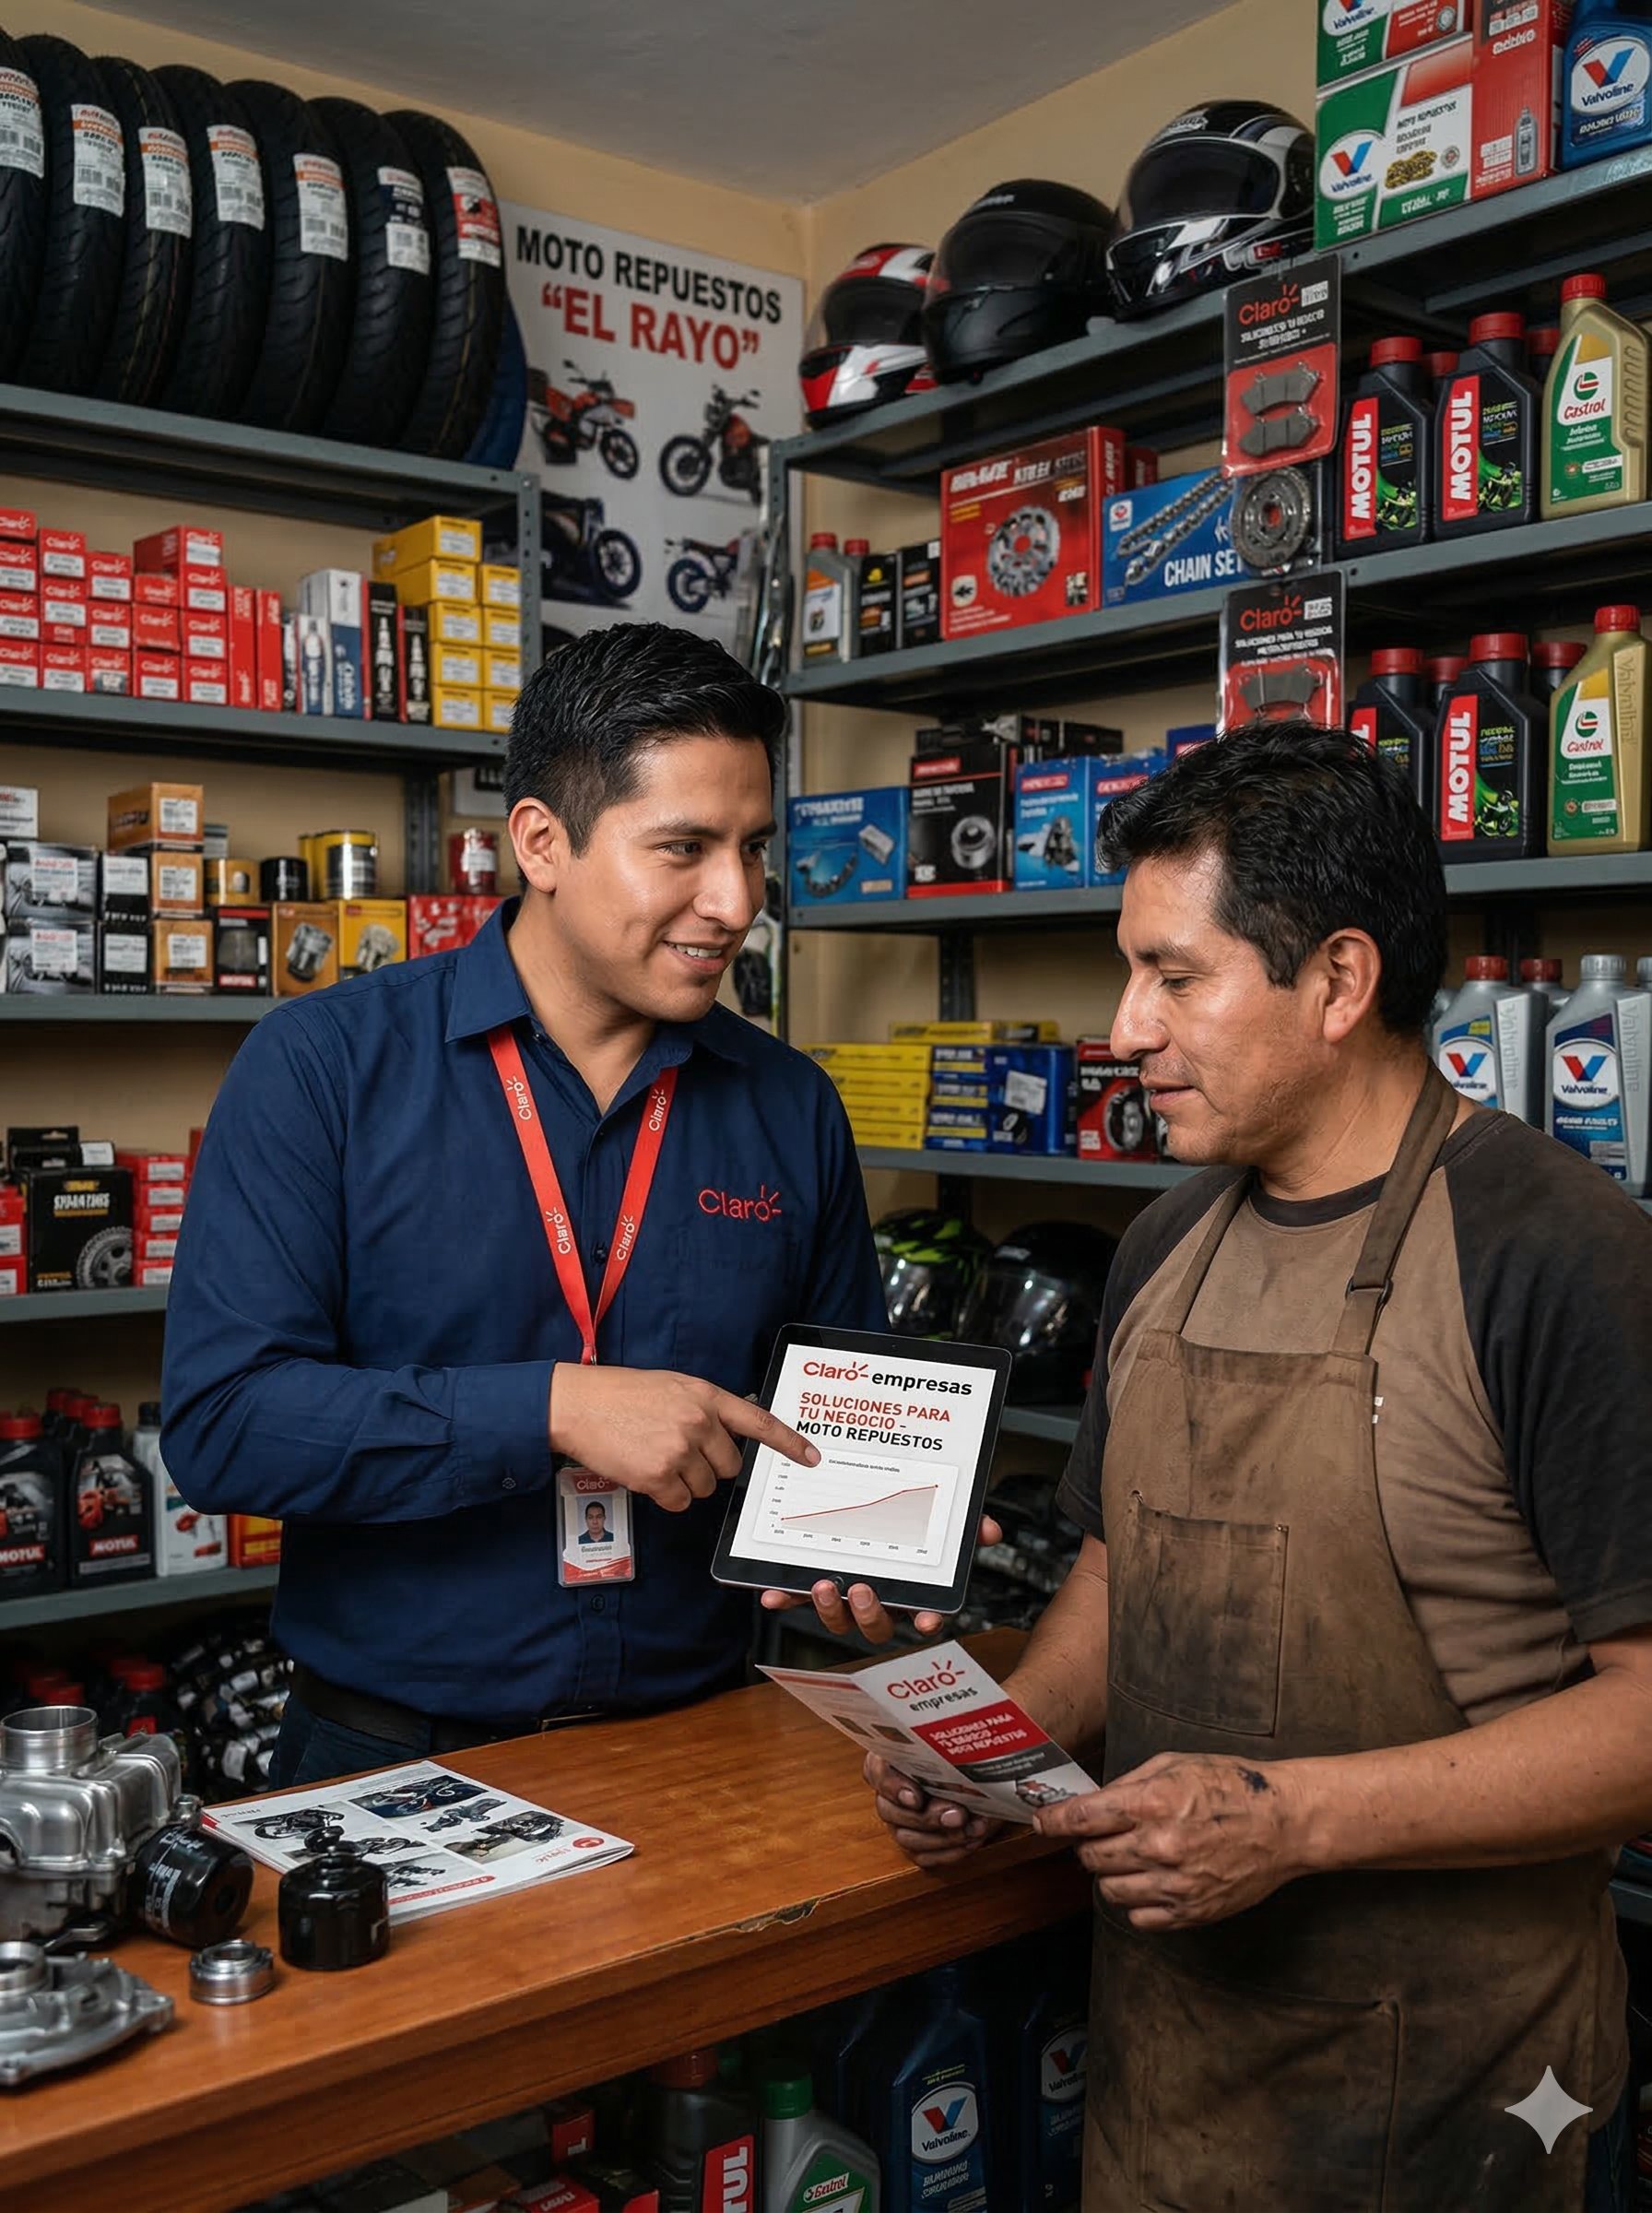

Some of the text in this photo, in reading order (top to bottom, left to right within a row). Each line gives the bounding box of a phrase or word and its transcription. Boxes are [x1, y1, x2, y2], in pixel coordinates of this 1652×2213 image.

[516, 225, 782, 325] MOTO REPUESTOS
[1238, 283, 1300, 325] Claro
[1351, 413, 1372, 520] MOTUL
[1448, 391, 1472, 502] MOTUL
[1164, 553, 1211, 587] CHAIN
[1239, 594, 1303, 632] Claro
[1448, 711, 1471, 822] MOTUL
[506, 1076, 532, 1120] Claro
[698, 1184, 782, 1222] Claro
[546, 1207, 572, 1254] Claro
[616, 1214, 636, 1260] Claro
[803, 1361, 973, 1395] Claro empresas
[798, 1406, 818, 1420] TU
[823, 1411, 896, 1430] NEGOCIO
[799, 1391, 950, 1422] SOLUCIONES PARA
[796, 1421, 943, 1450] MOTO REPUESTOS
[887, 1659, 965, 1700] Claro
[909, 1686, 978, 1713] empresas
